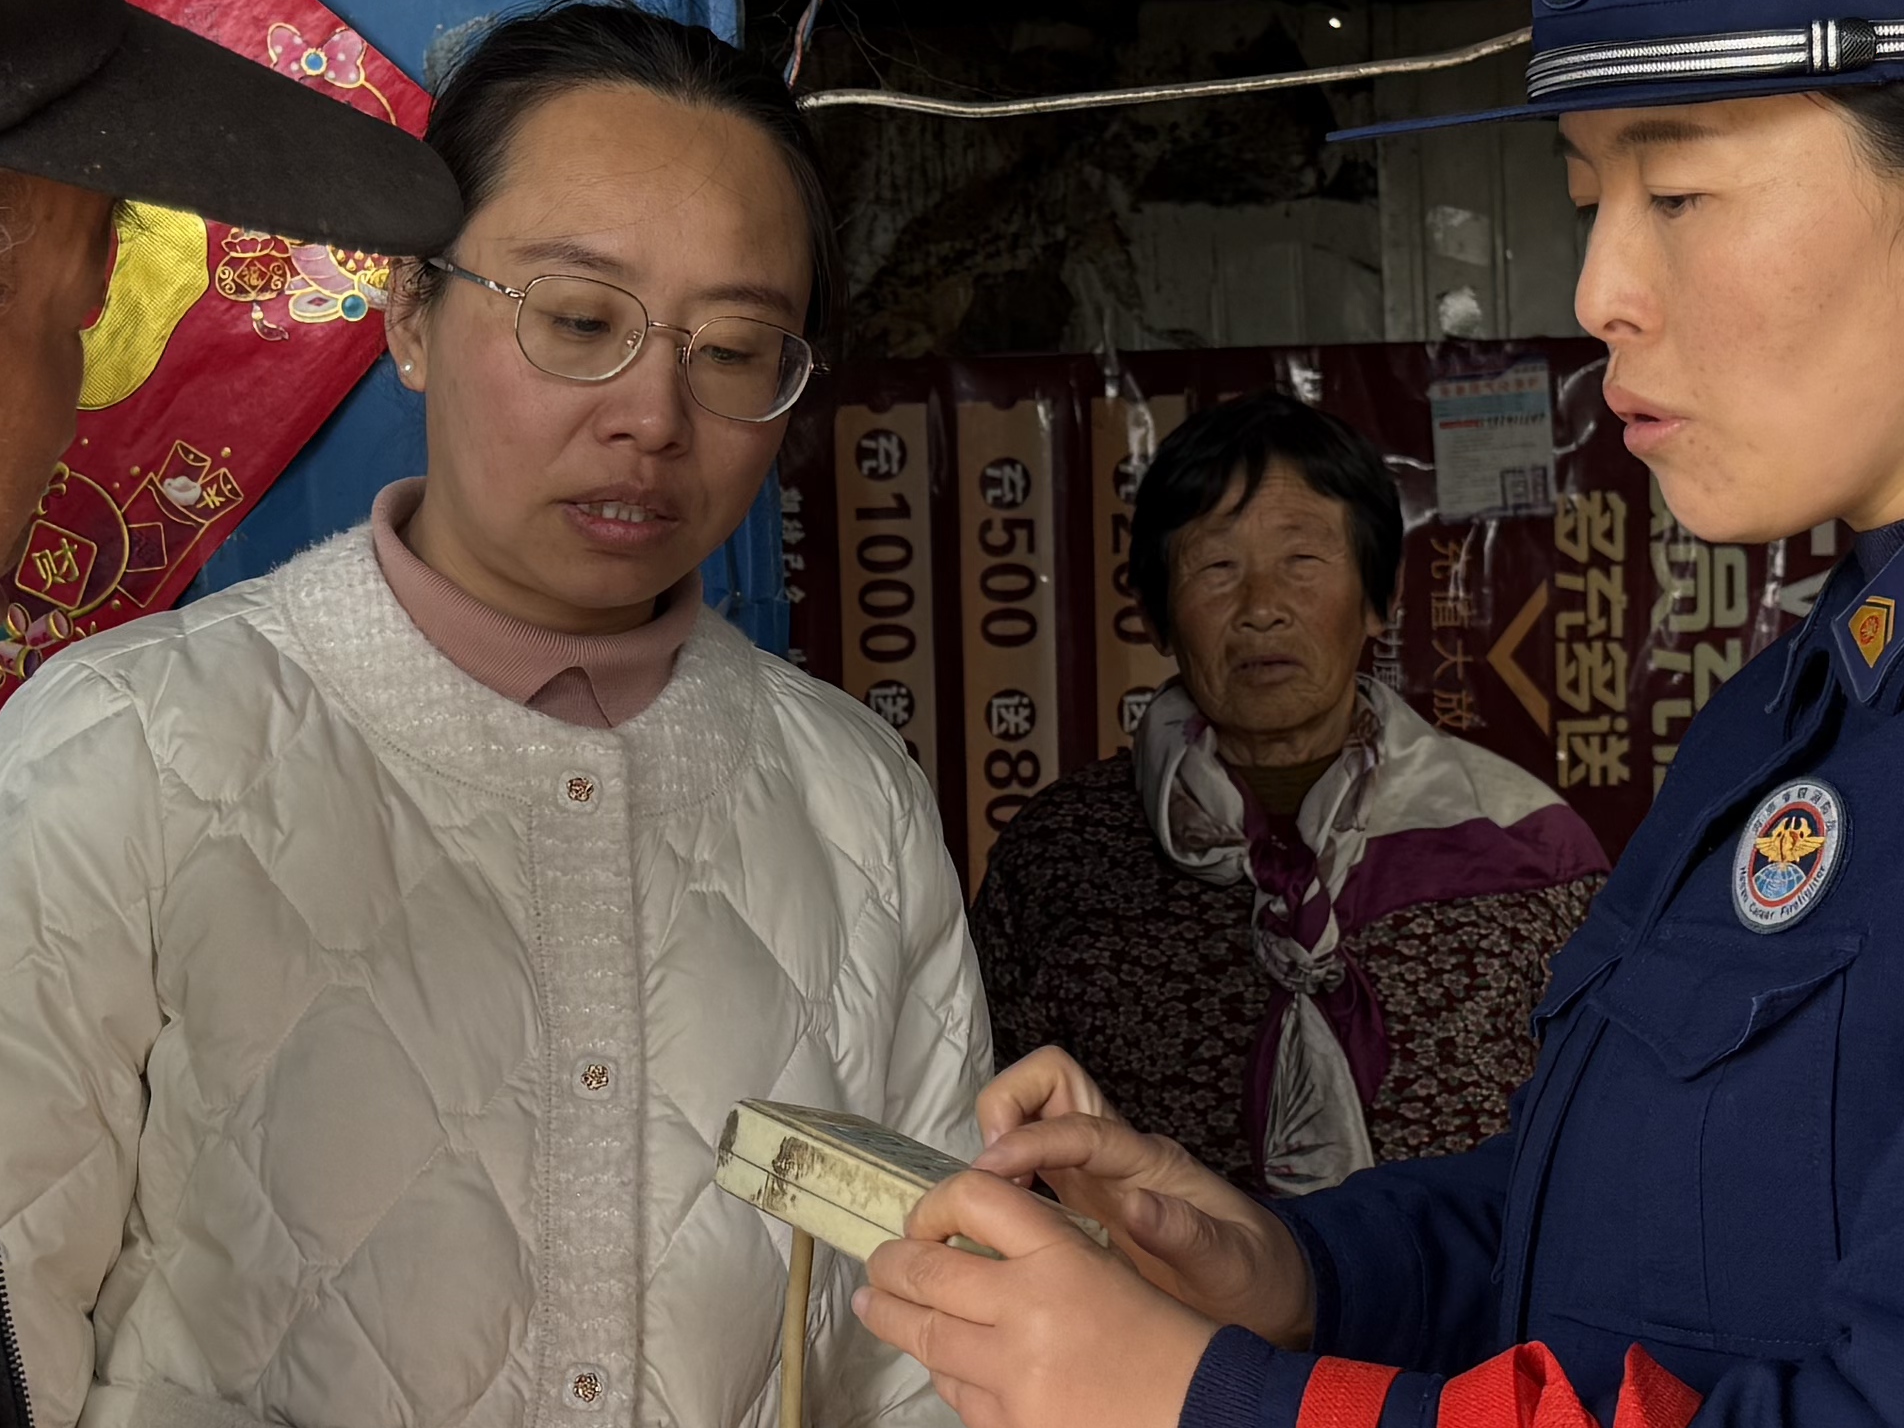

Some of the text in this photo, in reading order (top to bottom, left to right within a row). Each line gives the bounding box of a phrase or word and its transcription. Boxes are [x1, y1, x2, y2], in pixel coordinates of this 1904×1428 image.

[31, 537, 79, 593] 财
[1430, 537, 1476, 732] 充值大放
[1554, 489, 1630, 790] 多充多送
[1651, 468, 1750, 799] 员充
